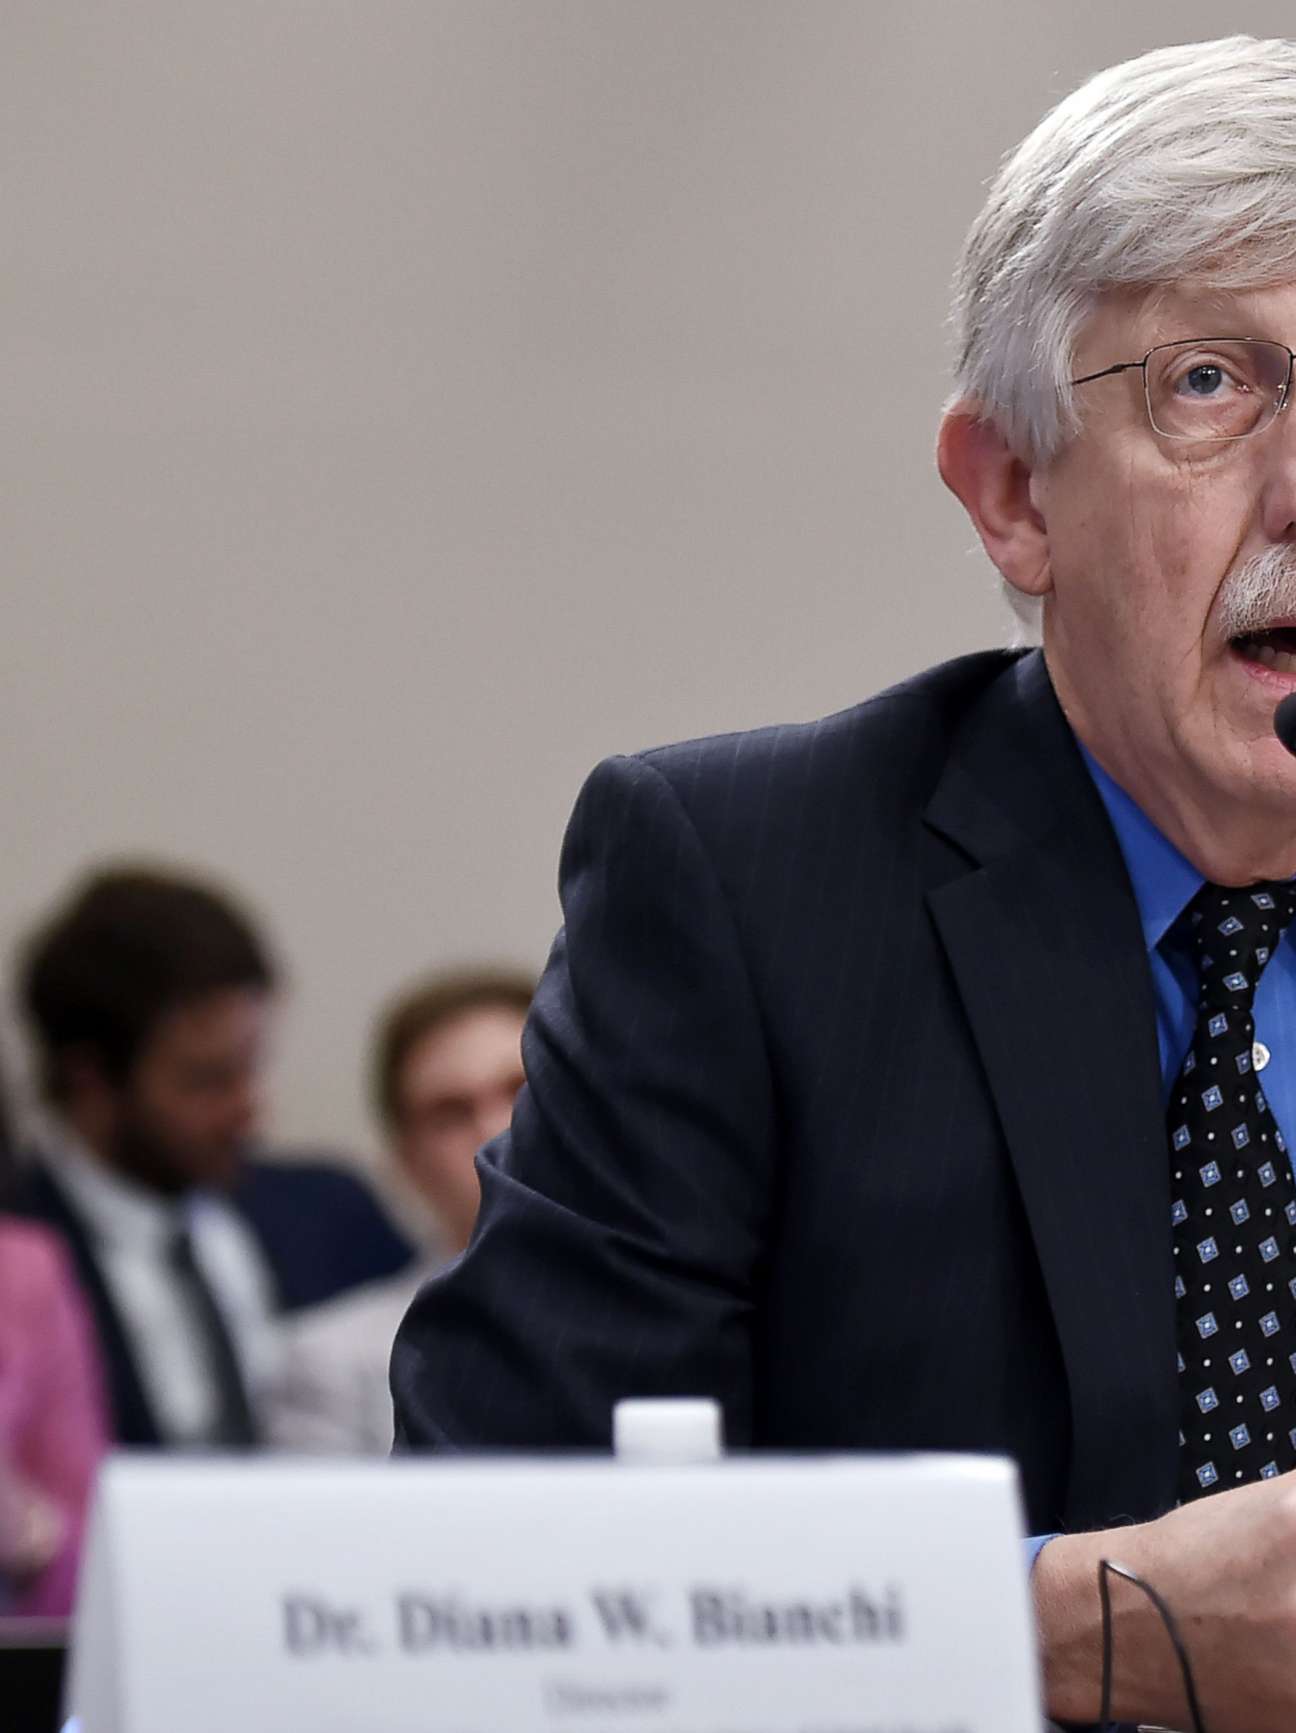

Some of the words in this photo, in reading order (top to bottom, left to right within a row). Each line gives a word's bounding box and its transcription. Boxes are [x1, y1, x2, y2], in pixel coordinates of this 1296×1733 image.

[282, 1590, 377, 1656] Dr.
[395, 1588, 574, 1654] Diana
[590, 1586, 670, 1648] W.
[687, 1582, 904, 1648] Bianchi
